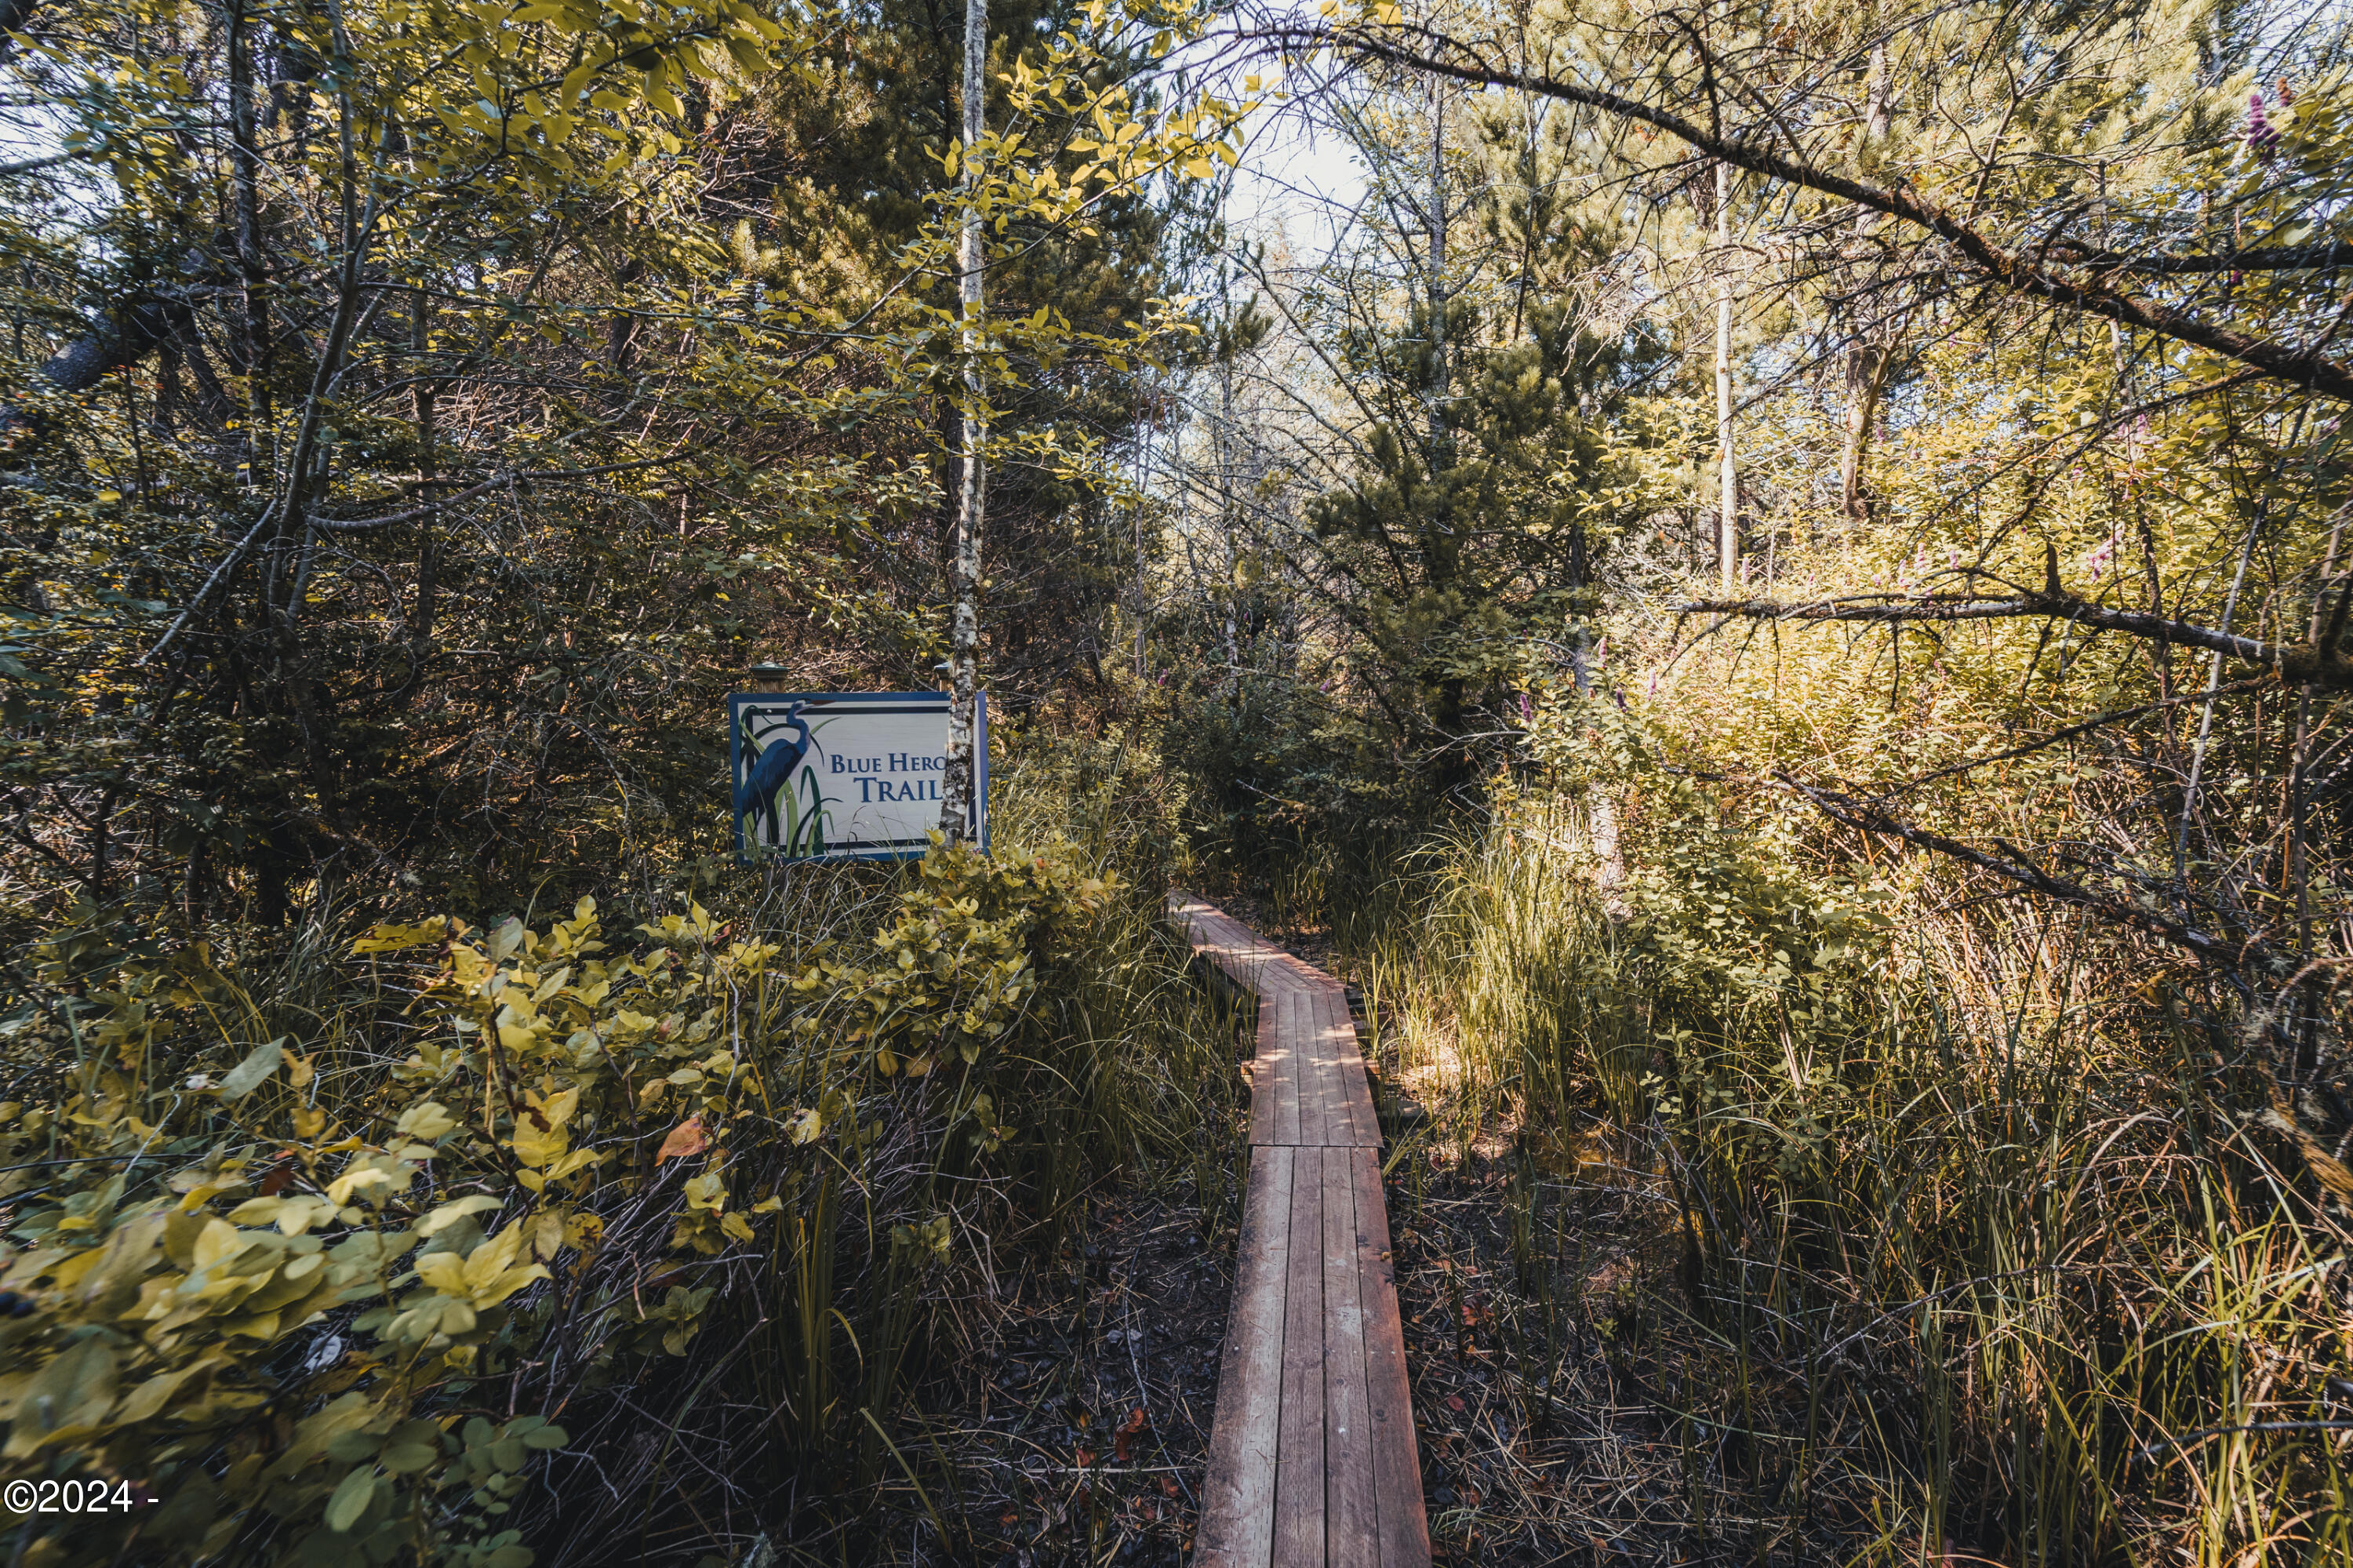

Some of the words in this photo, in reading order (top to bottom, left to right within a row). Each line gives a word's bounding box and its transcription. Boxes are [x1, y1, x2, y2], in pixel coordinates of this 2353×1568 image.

[830, 754, 882, 773] BLUE
[888, 752, 947, 772] HERO
[853, 777, 943, 803] TRAIL
